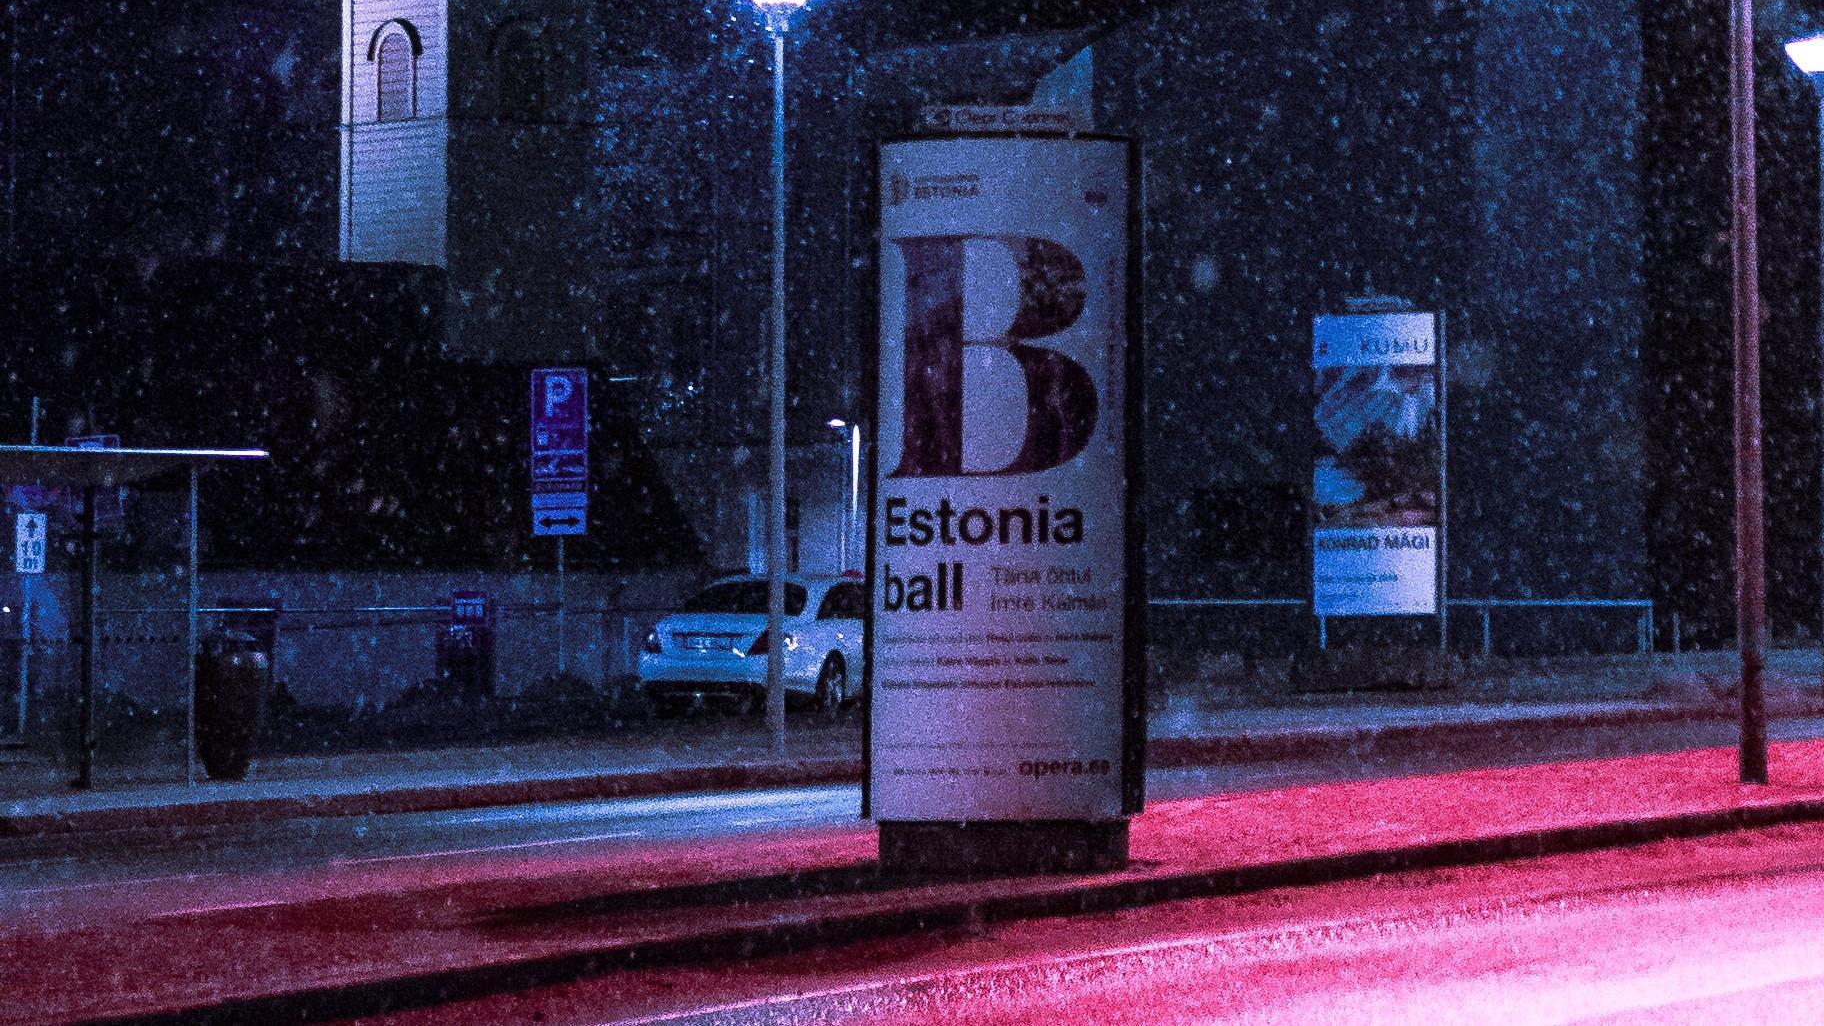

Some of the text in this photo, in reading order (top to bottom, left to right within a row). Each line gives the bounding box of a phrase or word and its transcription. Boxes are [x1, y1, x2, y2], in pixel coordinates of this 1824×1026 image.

[887, 234, 1098, 478] B
[1360, 337, 1429, 355] KUMU
[545, 375, 573, 417] P
[885, 495, 1084, 546] Estonia
[21, 540, 41, 556] 10
[883, 562, 964, 612] ball
[1018, 759, 1110, 780] opera.ee
